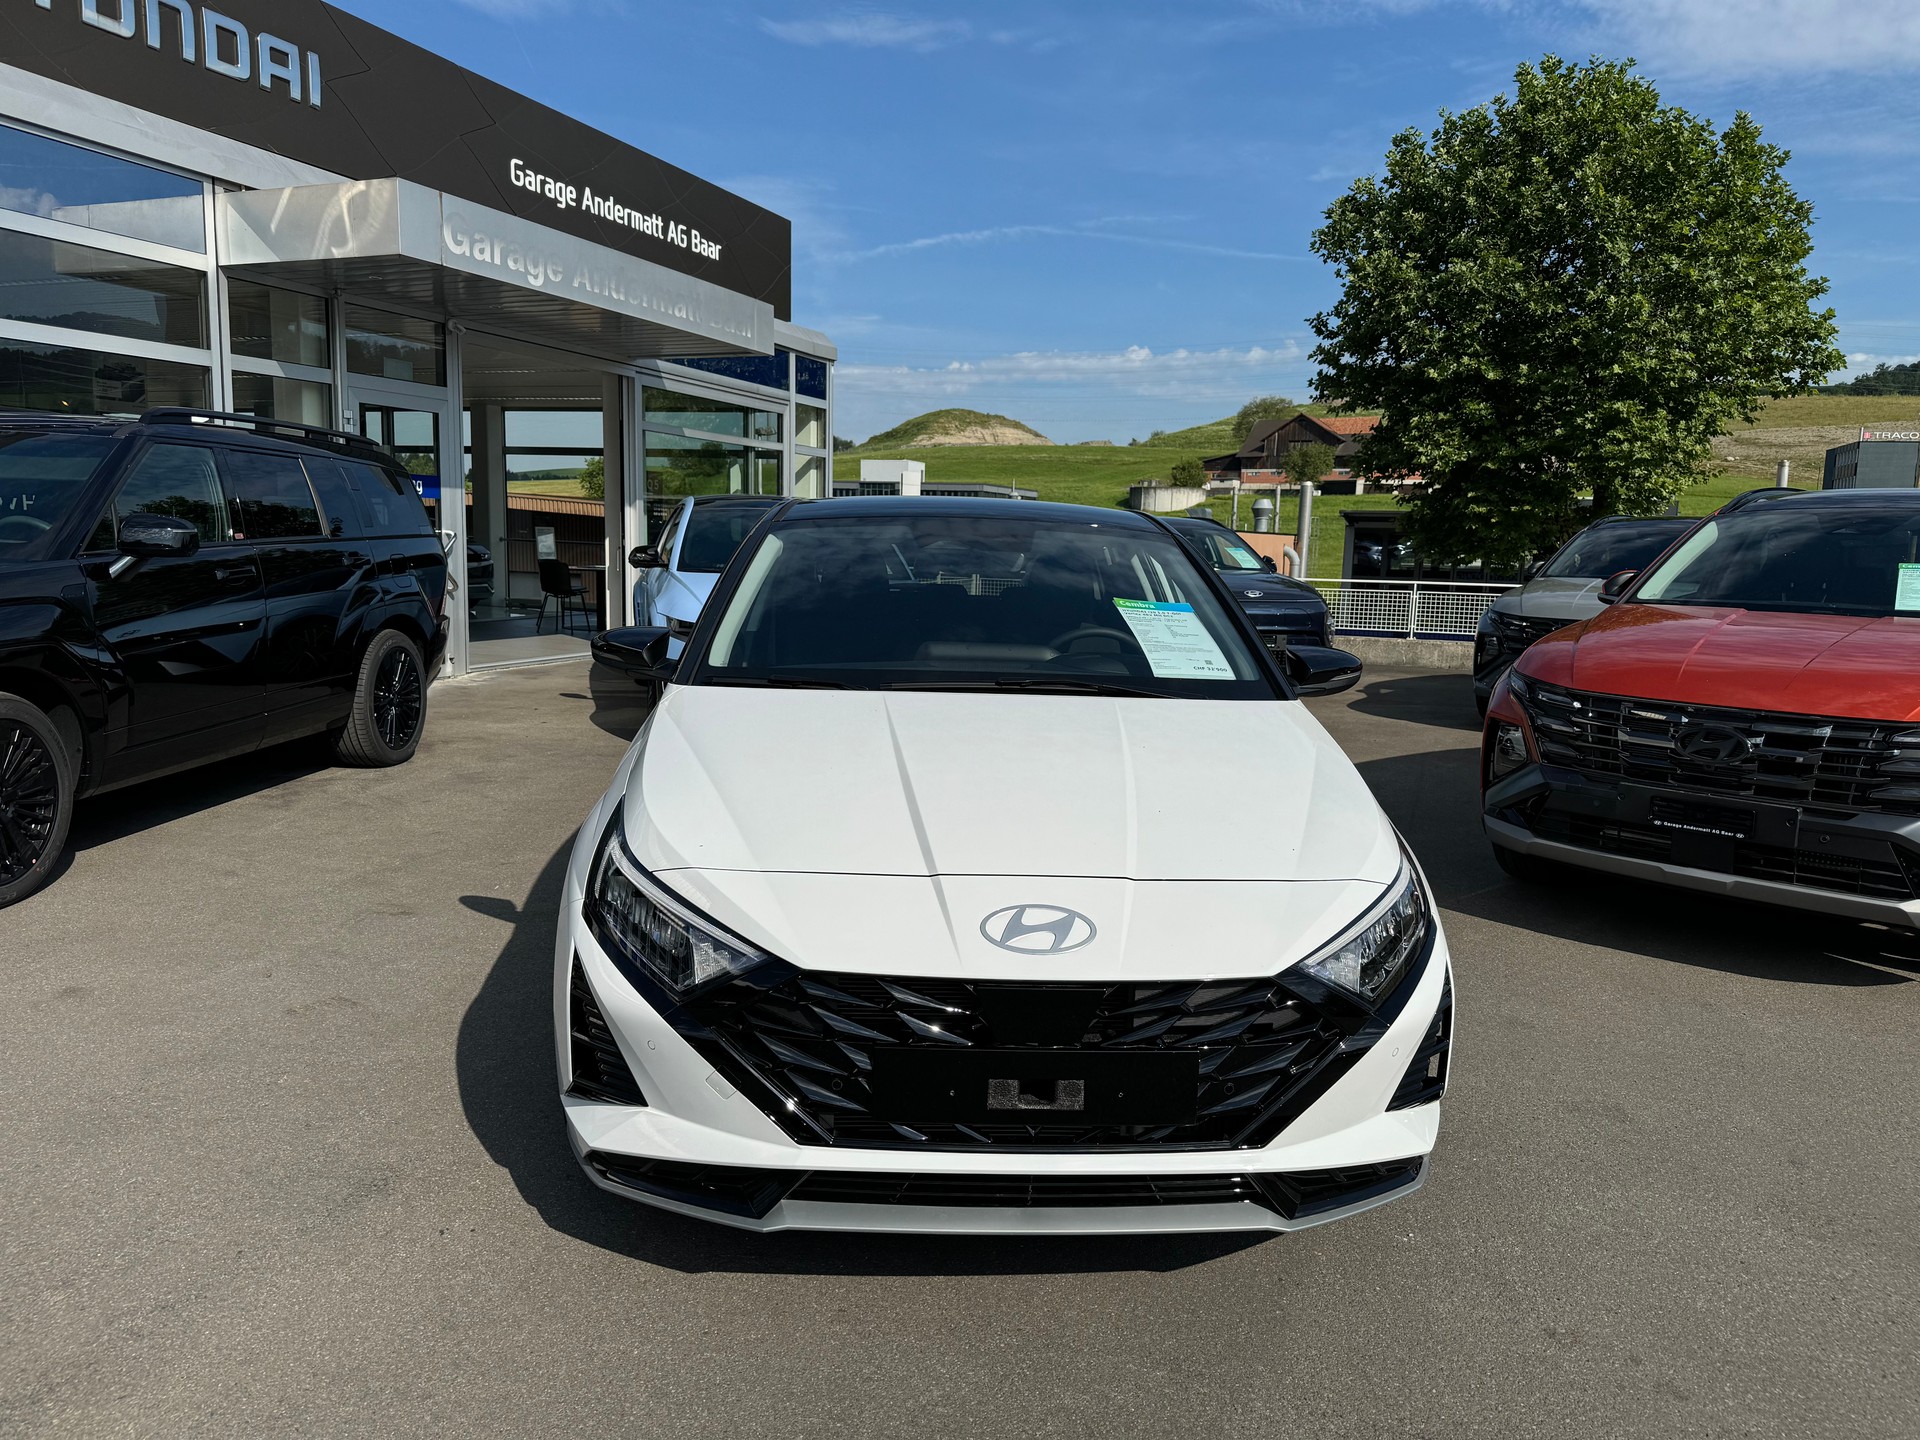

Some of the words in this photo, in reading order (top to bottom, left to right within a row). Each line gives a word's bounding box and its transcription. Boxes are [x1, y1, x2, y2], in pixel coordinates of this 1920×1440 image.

[35, 0, 321, 110] UNDAI
[510, 158, 577, 208] Garage
[581, 186, 664, 240] Andermatt
[667, 220, 688, 248] AG
[691, 228, 722, 261] Baar
[443, 211, 564, 287] Garage
[1874, 431, 1920, 439] TRACO
[1119, 600, 1156, 609] Cembra
[1683, 824, 1711, 832] Andermatt
